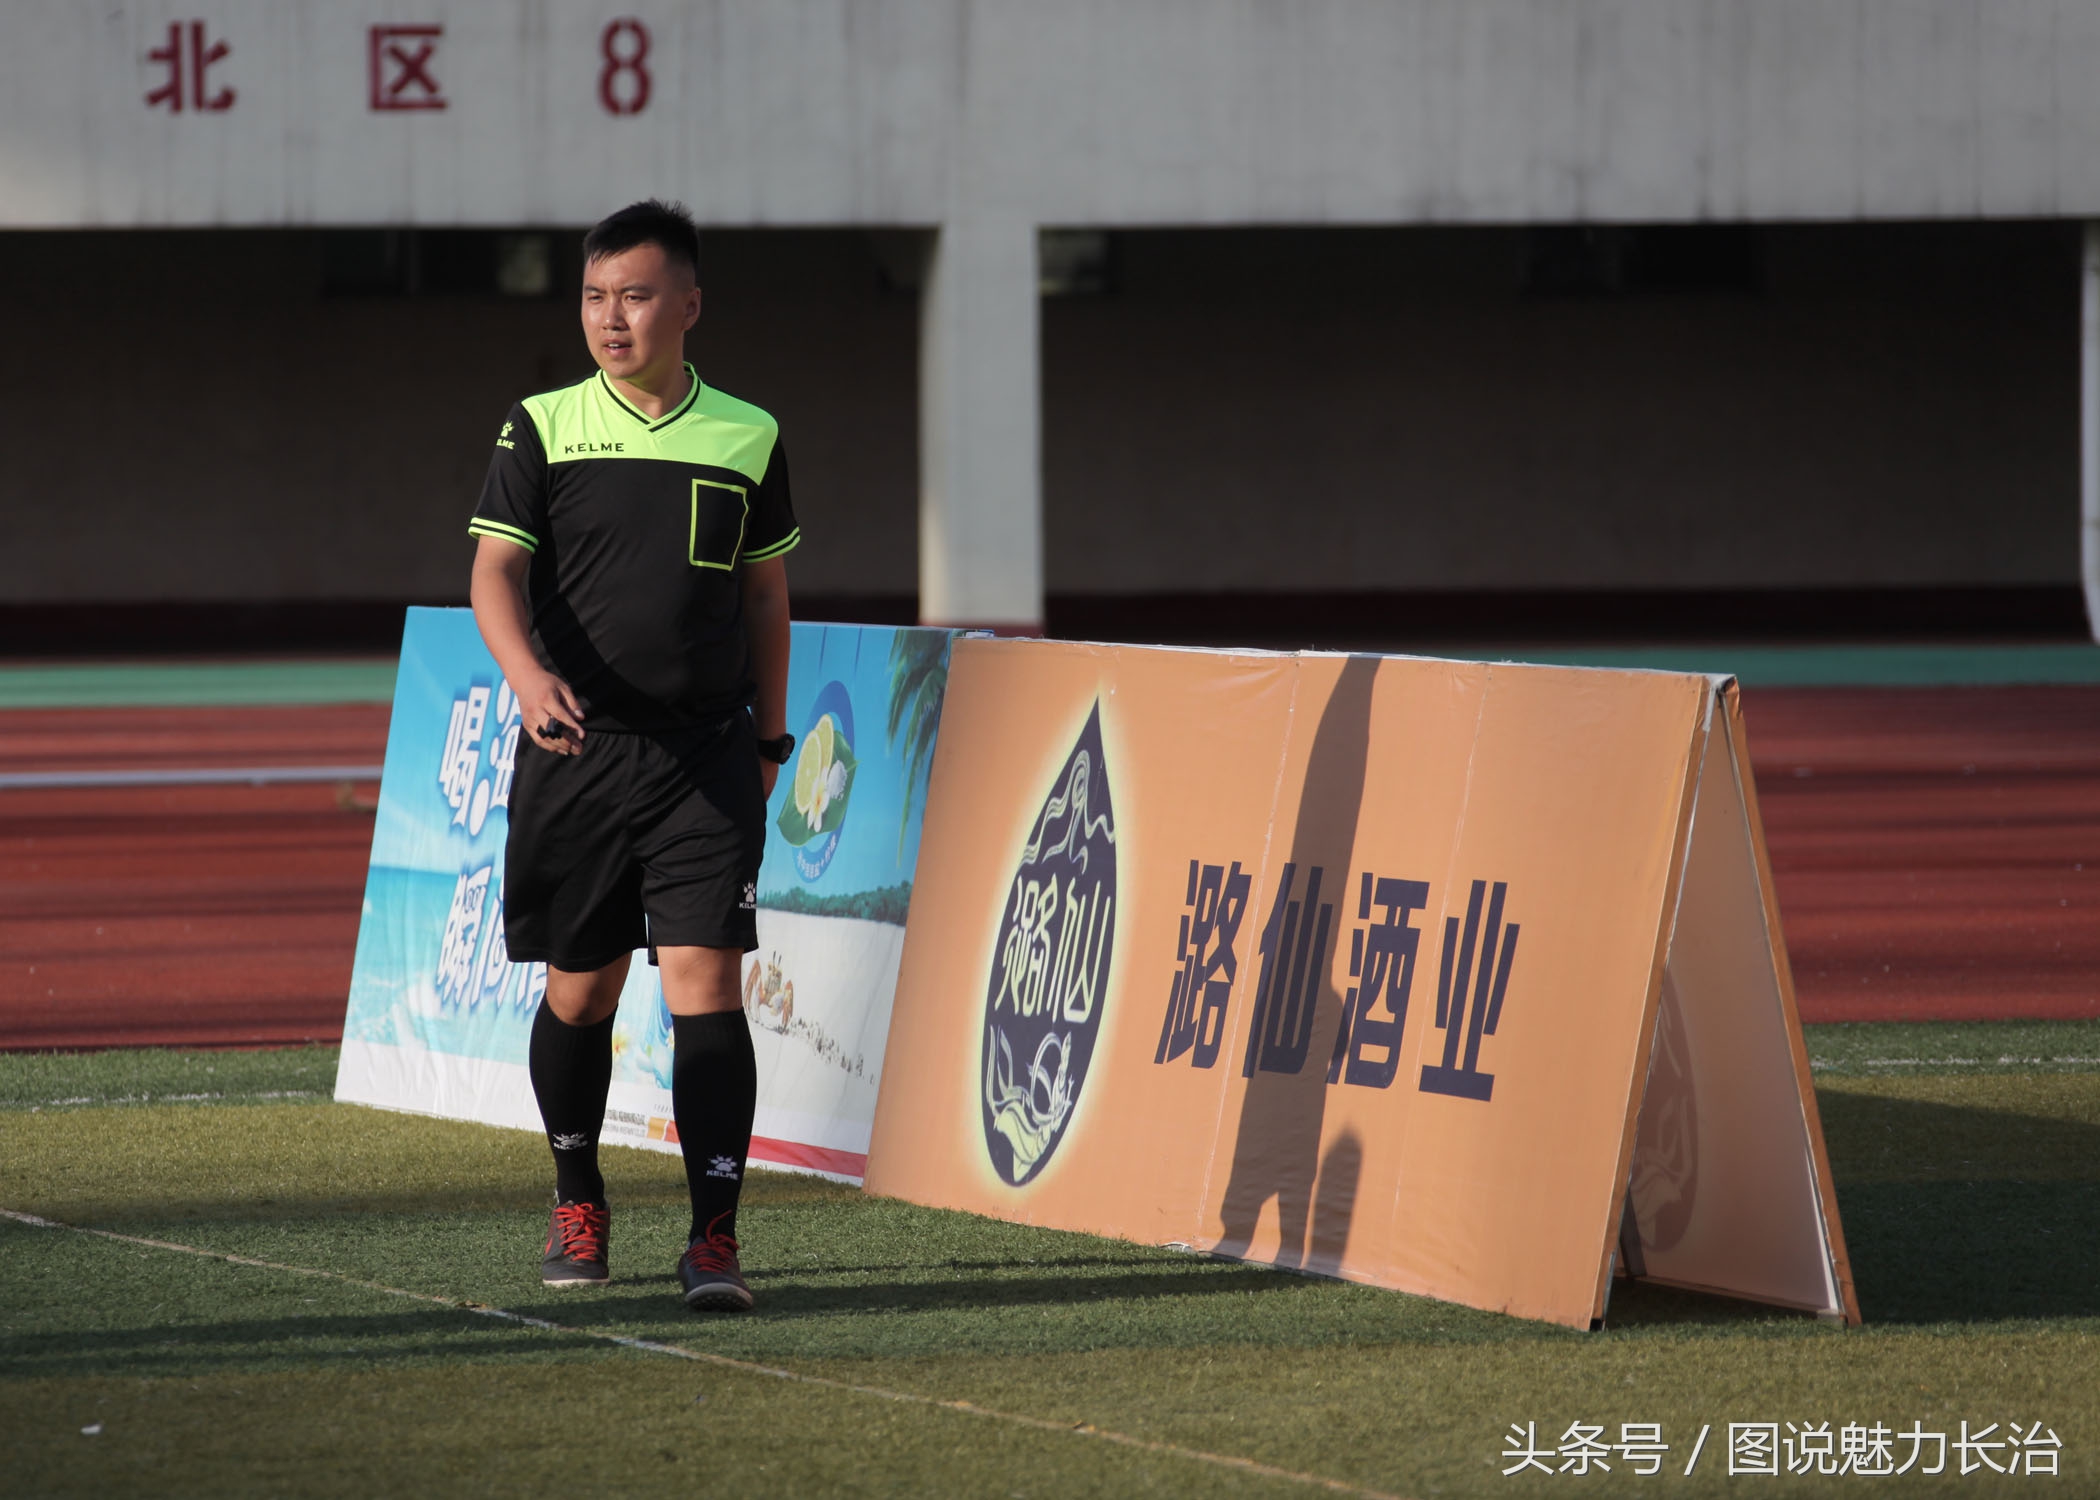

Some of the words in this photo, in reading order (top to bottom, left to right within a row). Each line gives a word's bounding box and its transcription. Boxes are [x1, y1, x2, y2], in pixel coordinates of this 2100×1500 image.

[564, 442, 625, 454] KELME
[1154, 859, 1520, 1102] 潞仙酒业
